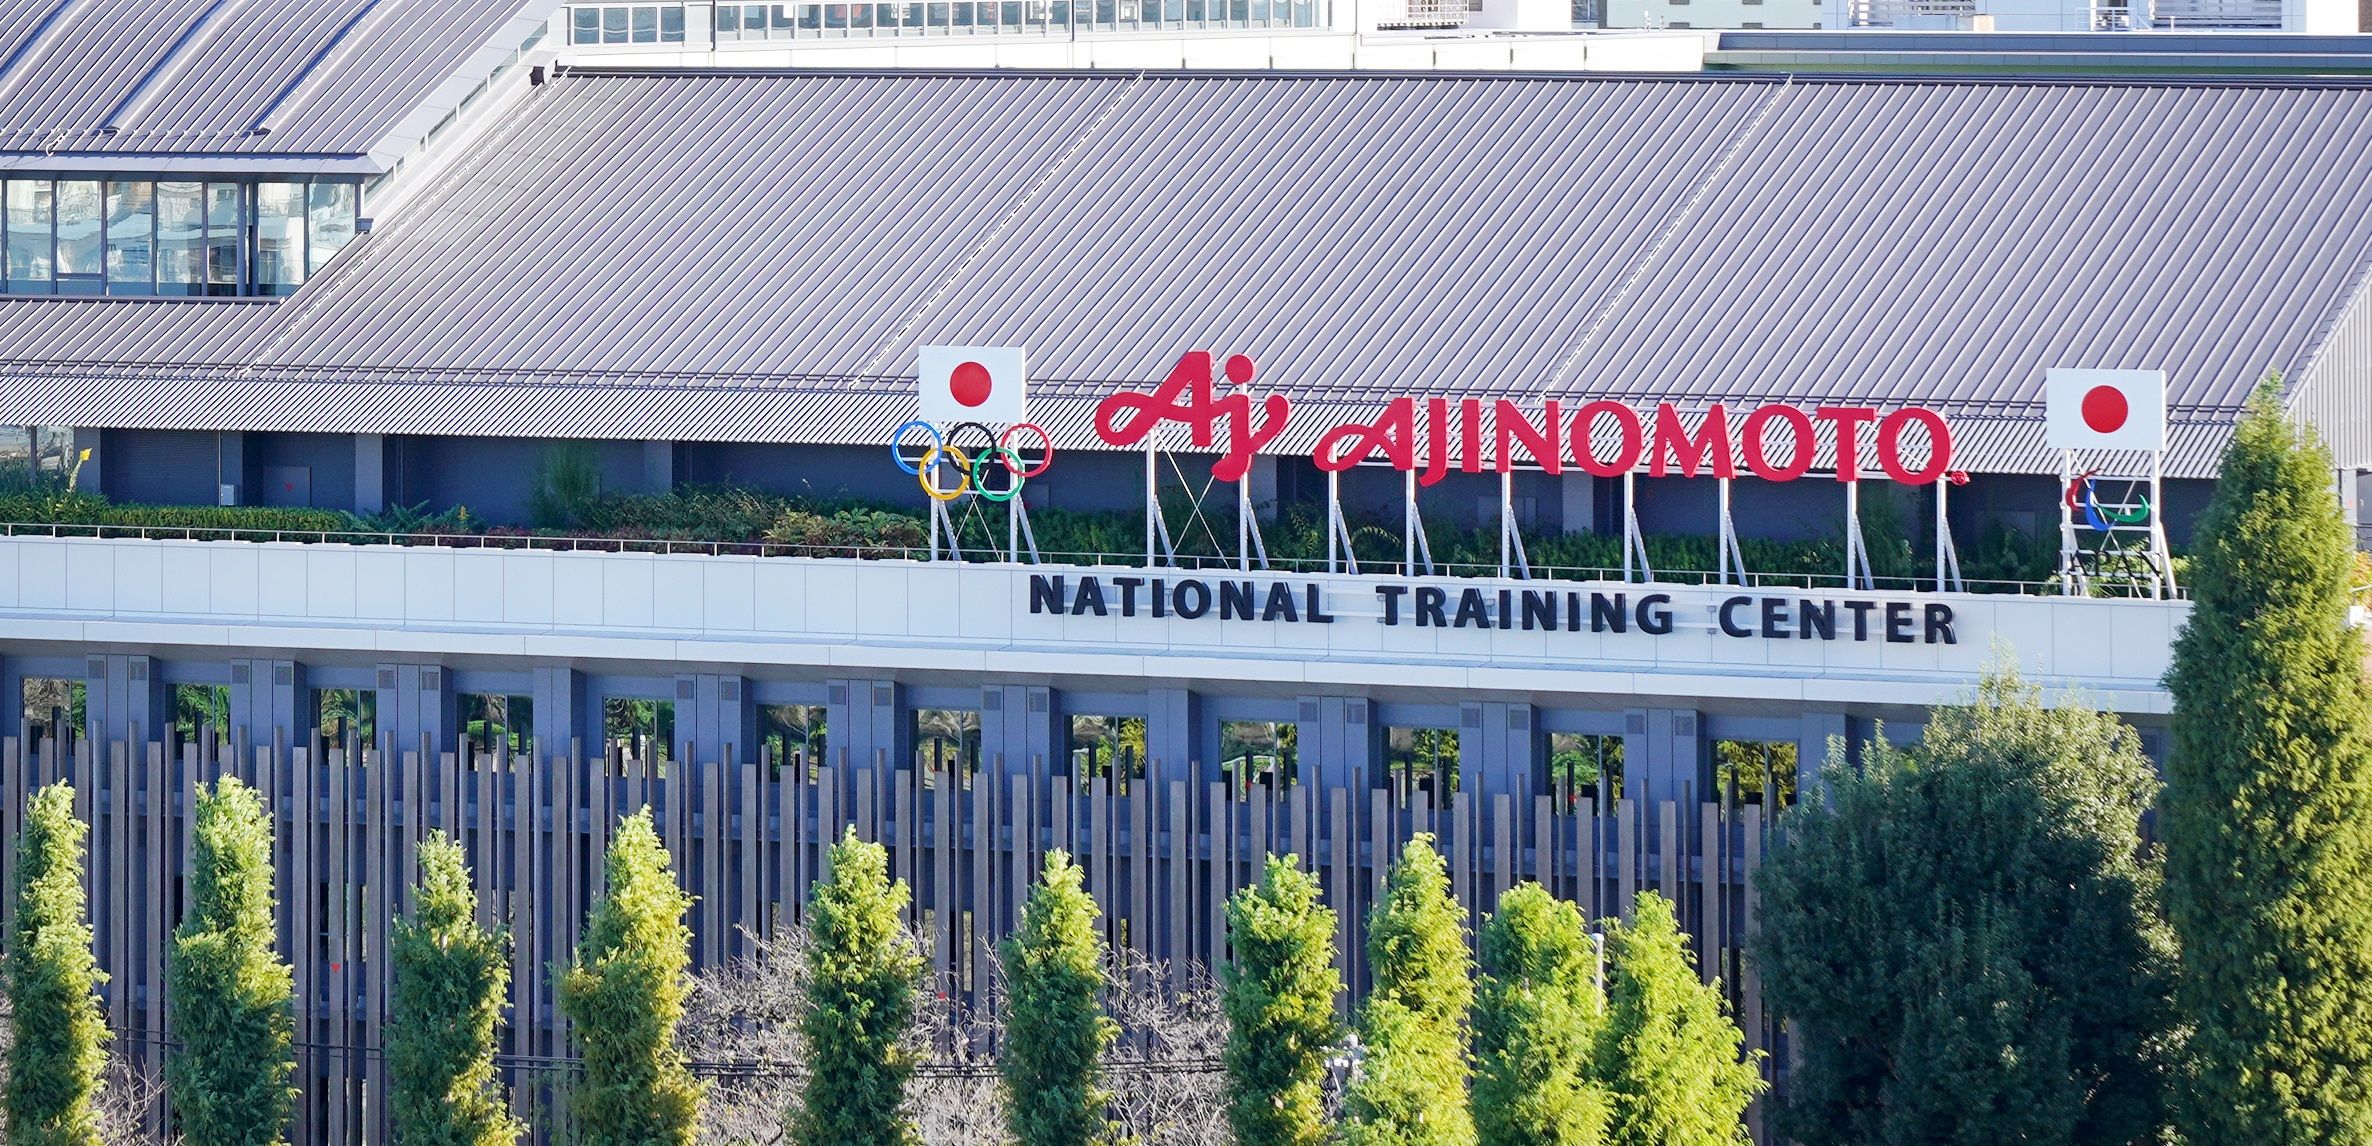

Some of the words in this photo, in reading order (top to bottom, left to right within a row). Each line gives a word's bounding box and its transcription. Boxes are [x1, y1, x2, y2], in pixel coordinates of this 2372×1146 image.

[1313, 397, 1953, 487] AJINOMOTO
[1030, 574, 1334, 624] NATIONAL
[1377, 585, 1674, 635] TRAINING
[1719, 597, 1958, 645] CENTER
